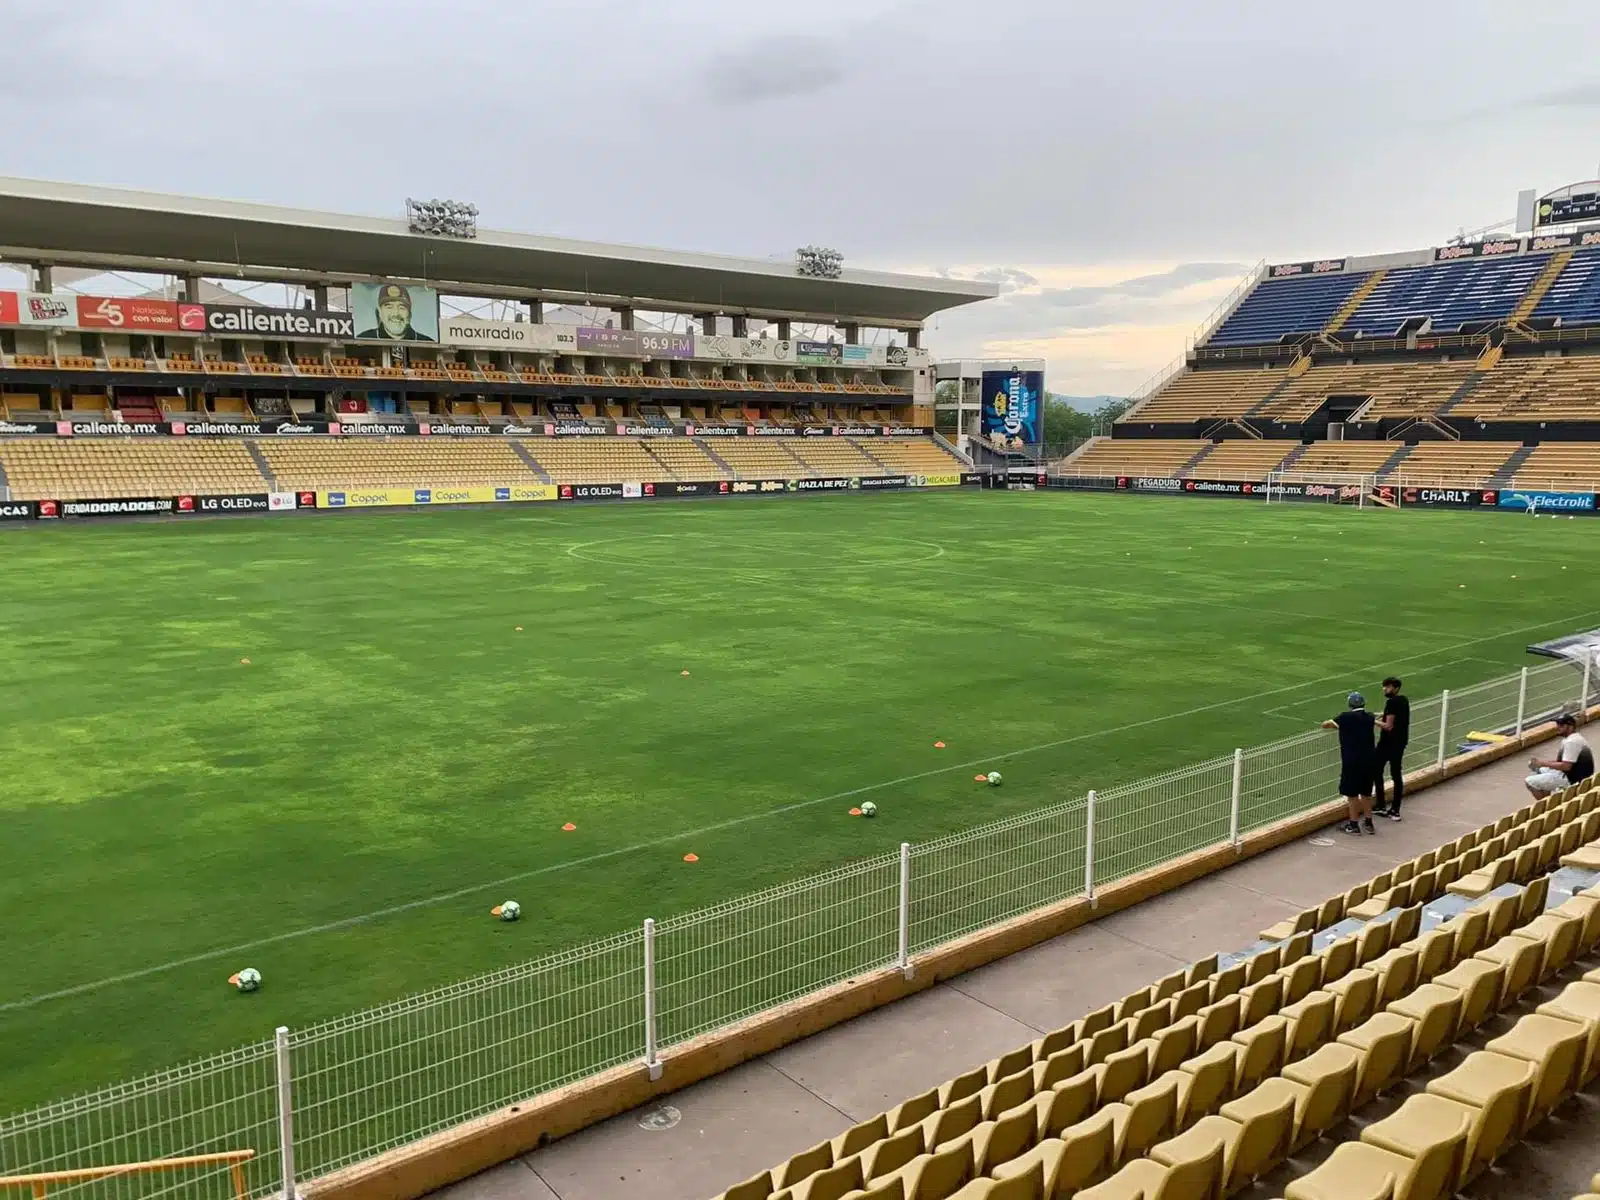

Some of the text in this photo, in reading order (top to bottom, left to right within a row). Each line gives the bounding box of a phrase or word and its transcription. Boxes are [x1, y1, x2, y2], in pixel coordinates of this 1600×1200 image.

[132, 315, 173, 324] con valor
[209, 308, 353, 336] caliente.mx
[449, 326, 524, 341] maxiradio
[642, 336, 668, 350] 96.9
[671, 337, 690, 352] FM
[1004, 376, 1021, 434] Corona
[73, 421, 157, 434] caliente.mx
[186, 422, 260, 434] caliente.mx
[341, 422, 406, 434] caliente.mx
[431, 423, 490, 434] caliente.mx
[554, 424, 606, 435] caliente.mx
[626, 424, 673, 435] caliente.mx
[694, 426, 738, 435] caliente.mx
[755, 426, 796, 435] caliente.mx
[839, 426, 876, 435] caliente.mx
[798, 480, 848, 489] HAZLA DE PEZ
[1138, 478, 1181, 487] PEGADURO
[1194, 482, 1240, 492] caliente.mx
[435, 491, 471, 501] Coppel
[514, 488, 546, 498] Coppel
[577, 487, 589, 496] LG
[590, 487, 611, 495] OLED
[1421, 490, 1470, 503] CHARLY
[201, 499, 218, 509] LG
[221, 498, 252, 509] OLED
[350, 492, 388, 504] Coppel
[1534, 495, 1593, 508] Electrolit
